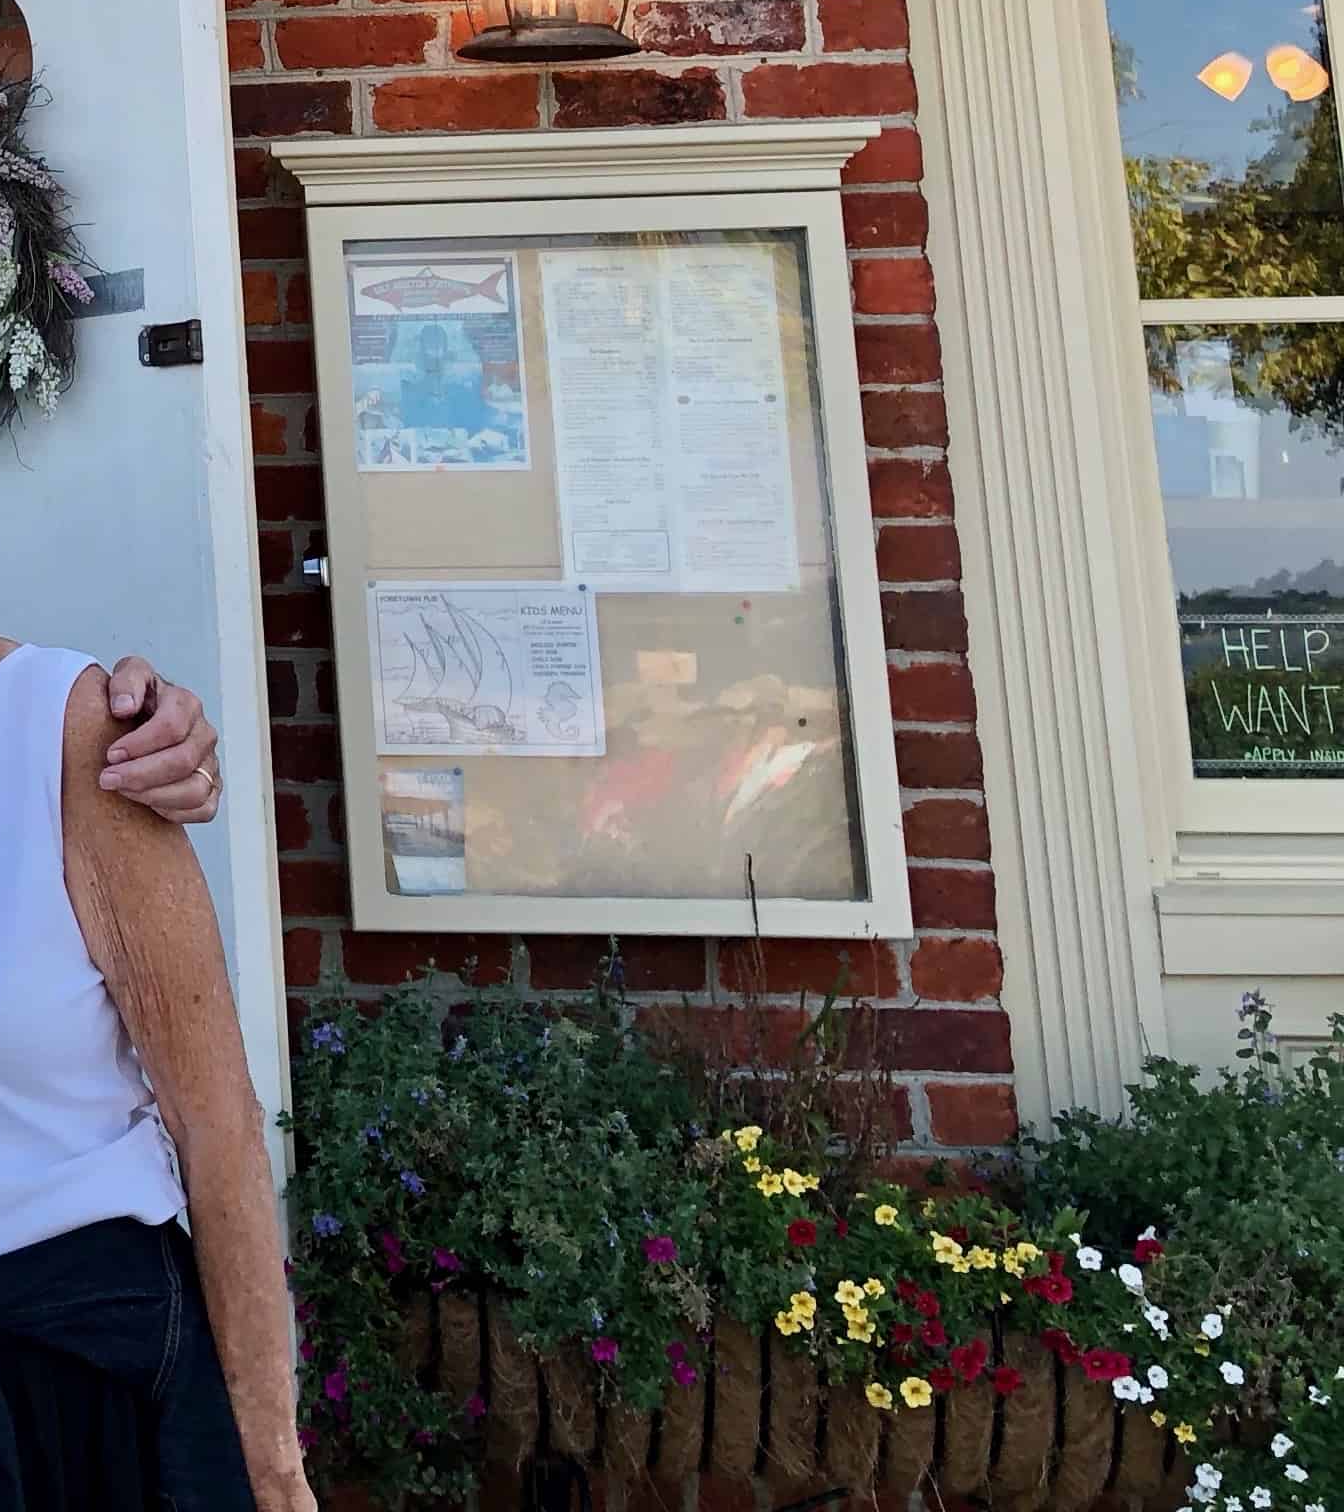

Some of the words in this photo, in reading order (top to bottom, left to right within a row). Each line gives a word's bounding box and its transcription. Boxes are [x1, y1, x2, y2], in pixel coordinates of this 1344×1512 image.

[520, 604, 547, 617] KIDS
[550, 604, 583, 617] MENU
[1221, 627, 1331, 673] HELP
[1211, 678, 1342, 735] WANT
[1253, 745, 1297, 762] APPLY
